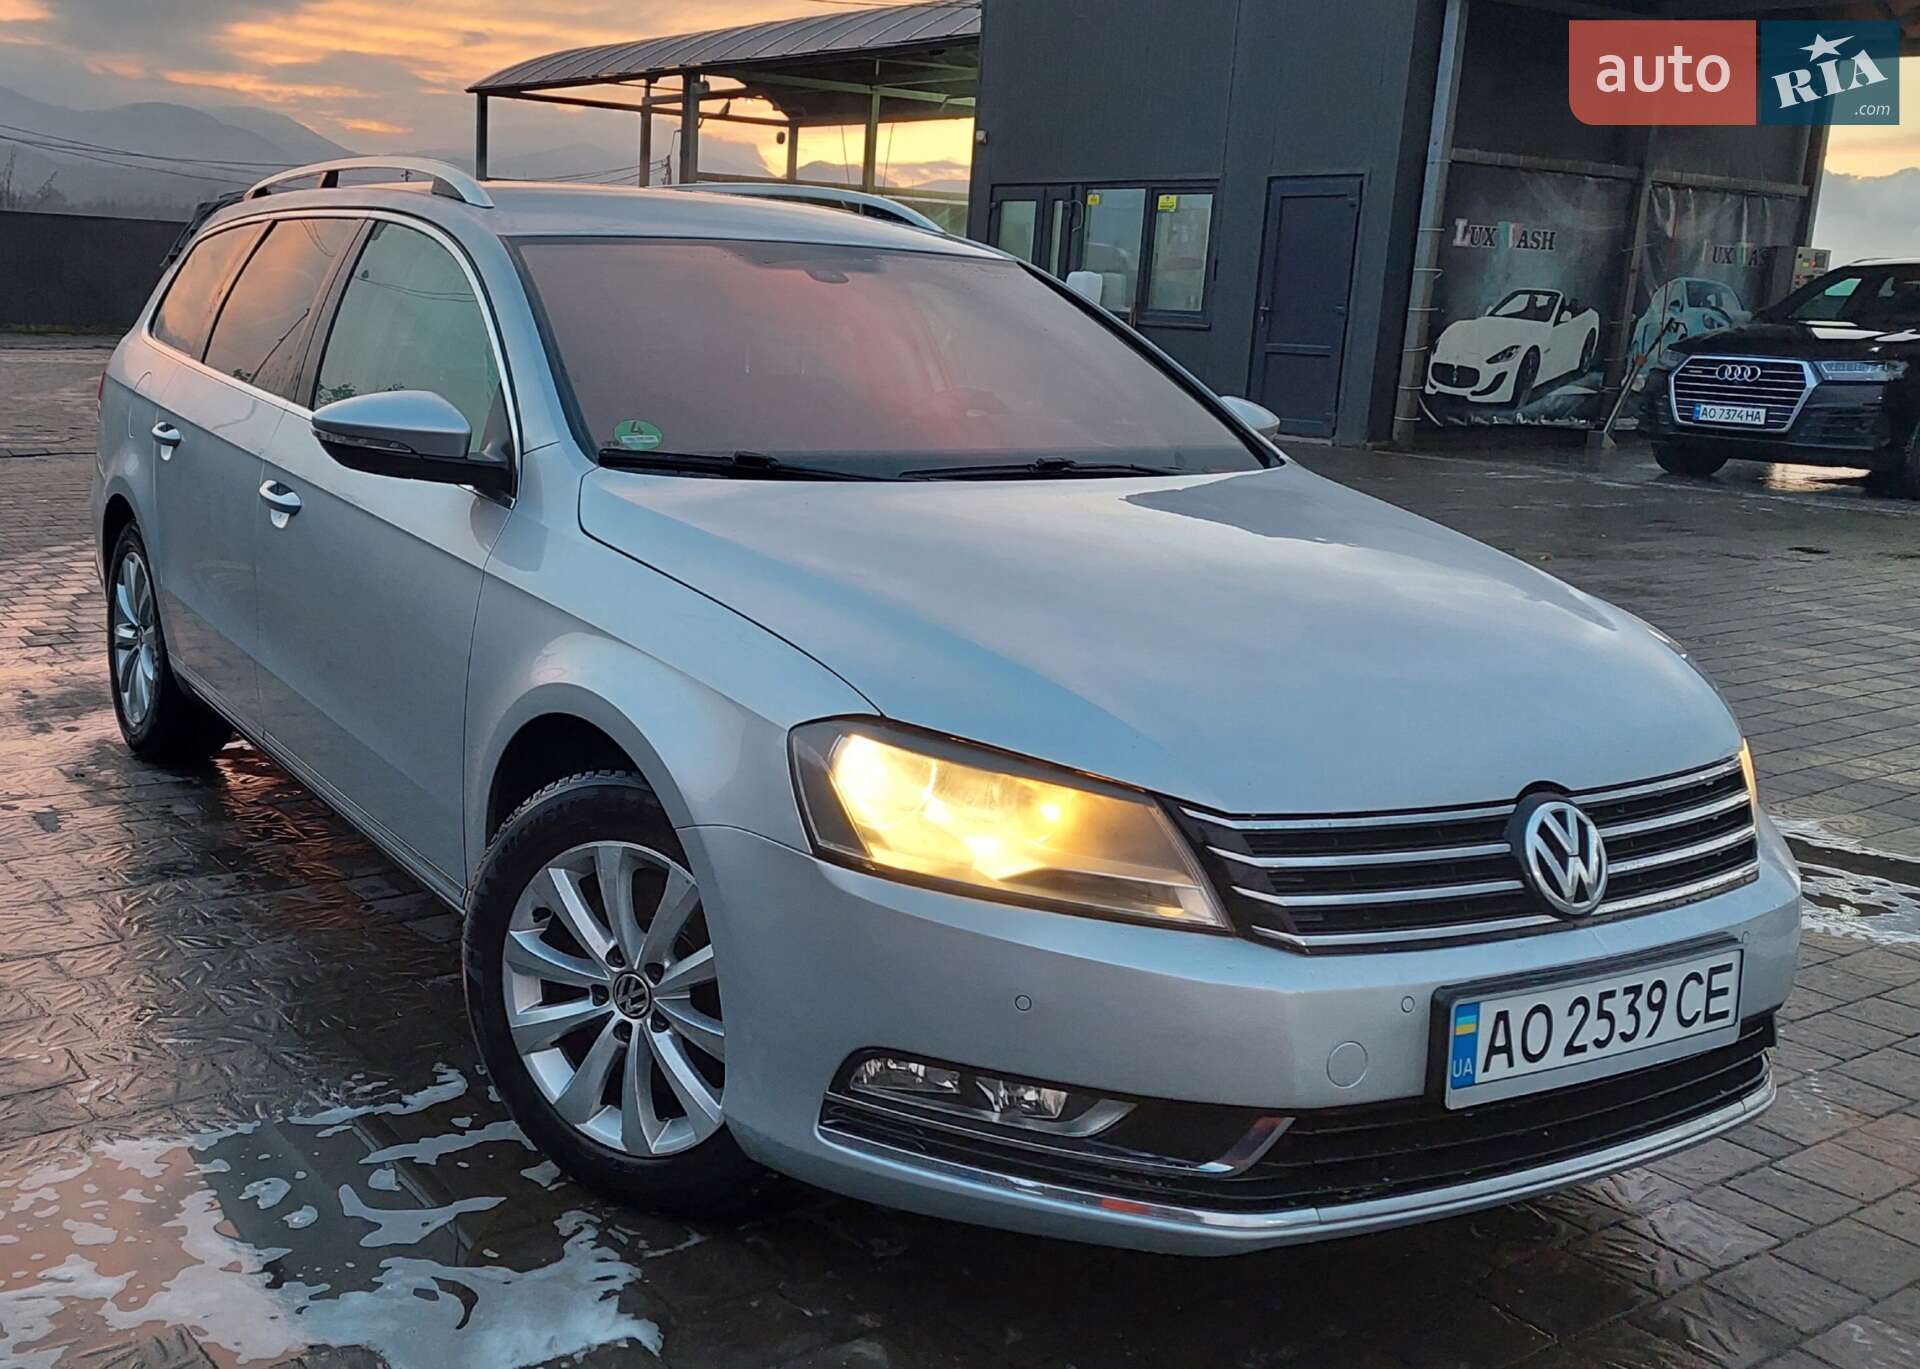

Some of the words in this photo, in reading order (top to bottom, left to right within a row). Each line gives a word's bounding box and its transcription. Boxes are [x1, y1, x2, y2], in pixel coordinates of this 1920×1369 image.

[1453, 218, 1497, 248] LUX
[1701, 407, 1717, 419] AO
[1718, 408, 1744, 421] 7374
[1745, 410, 1761, 423] HA
[1481, 1003, 1554, 1074] AO
[1563, 979, 1667, 1057] 2539
[1676, 962, 1734, 1028] CE
[1452, 1057, 1473, 1078] UA
